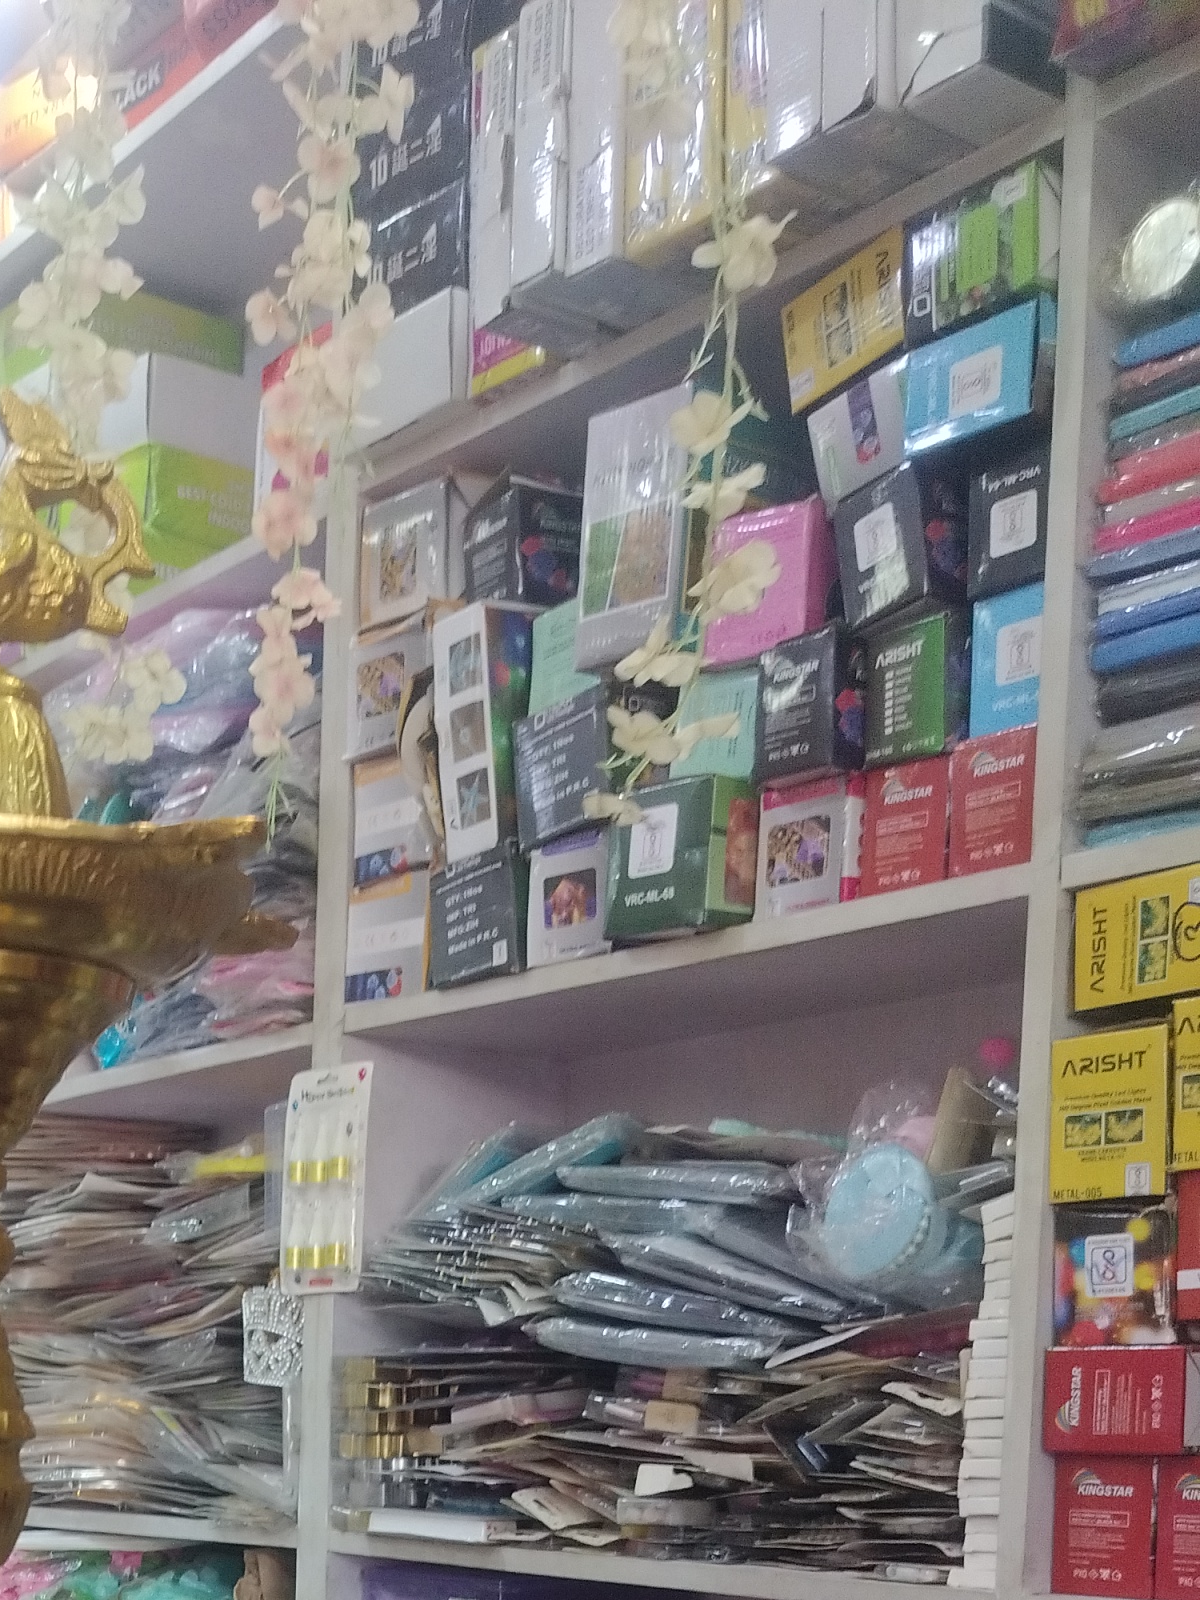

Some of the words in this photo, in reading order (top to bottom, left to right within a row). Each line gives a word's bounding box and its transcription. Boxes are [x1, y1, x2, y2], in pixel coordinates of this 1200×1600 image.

[875, 639, 925, 671] ARISHT
[973, 753, 1025, 778] KINGSTAR
[883, 784, 934, 806] KINGSTAR
[1089, 906, 1108, 994] ARISHT
[1061, 1048, 1148, 1079] ARISHT
[1070, 1366, 1082, 1428] KINGSTAR
[1077, 1484, 1134, 1498] KINGSTAR
